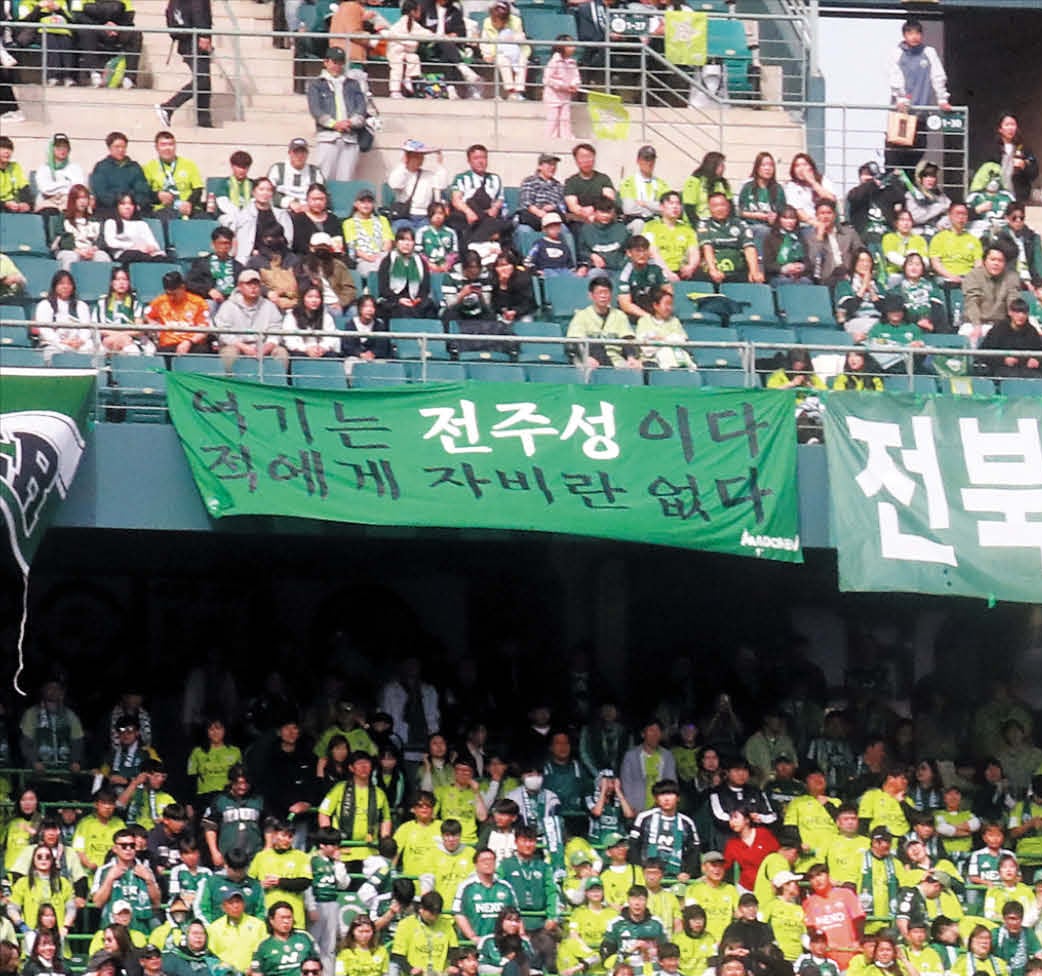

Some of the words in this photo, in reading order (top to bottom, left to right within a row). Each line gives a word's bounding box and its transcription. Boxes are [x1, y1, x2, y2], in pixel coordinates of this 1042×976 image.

[192, 388, 393, 451] 여기는
[419, 398, 622, 460] 전주성
[199, 443, 404, 503] 적에게
[427, 460, 629, 510] 자비란
[646, 463, 778, 524] 없다
